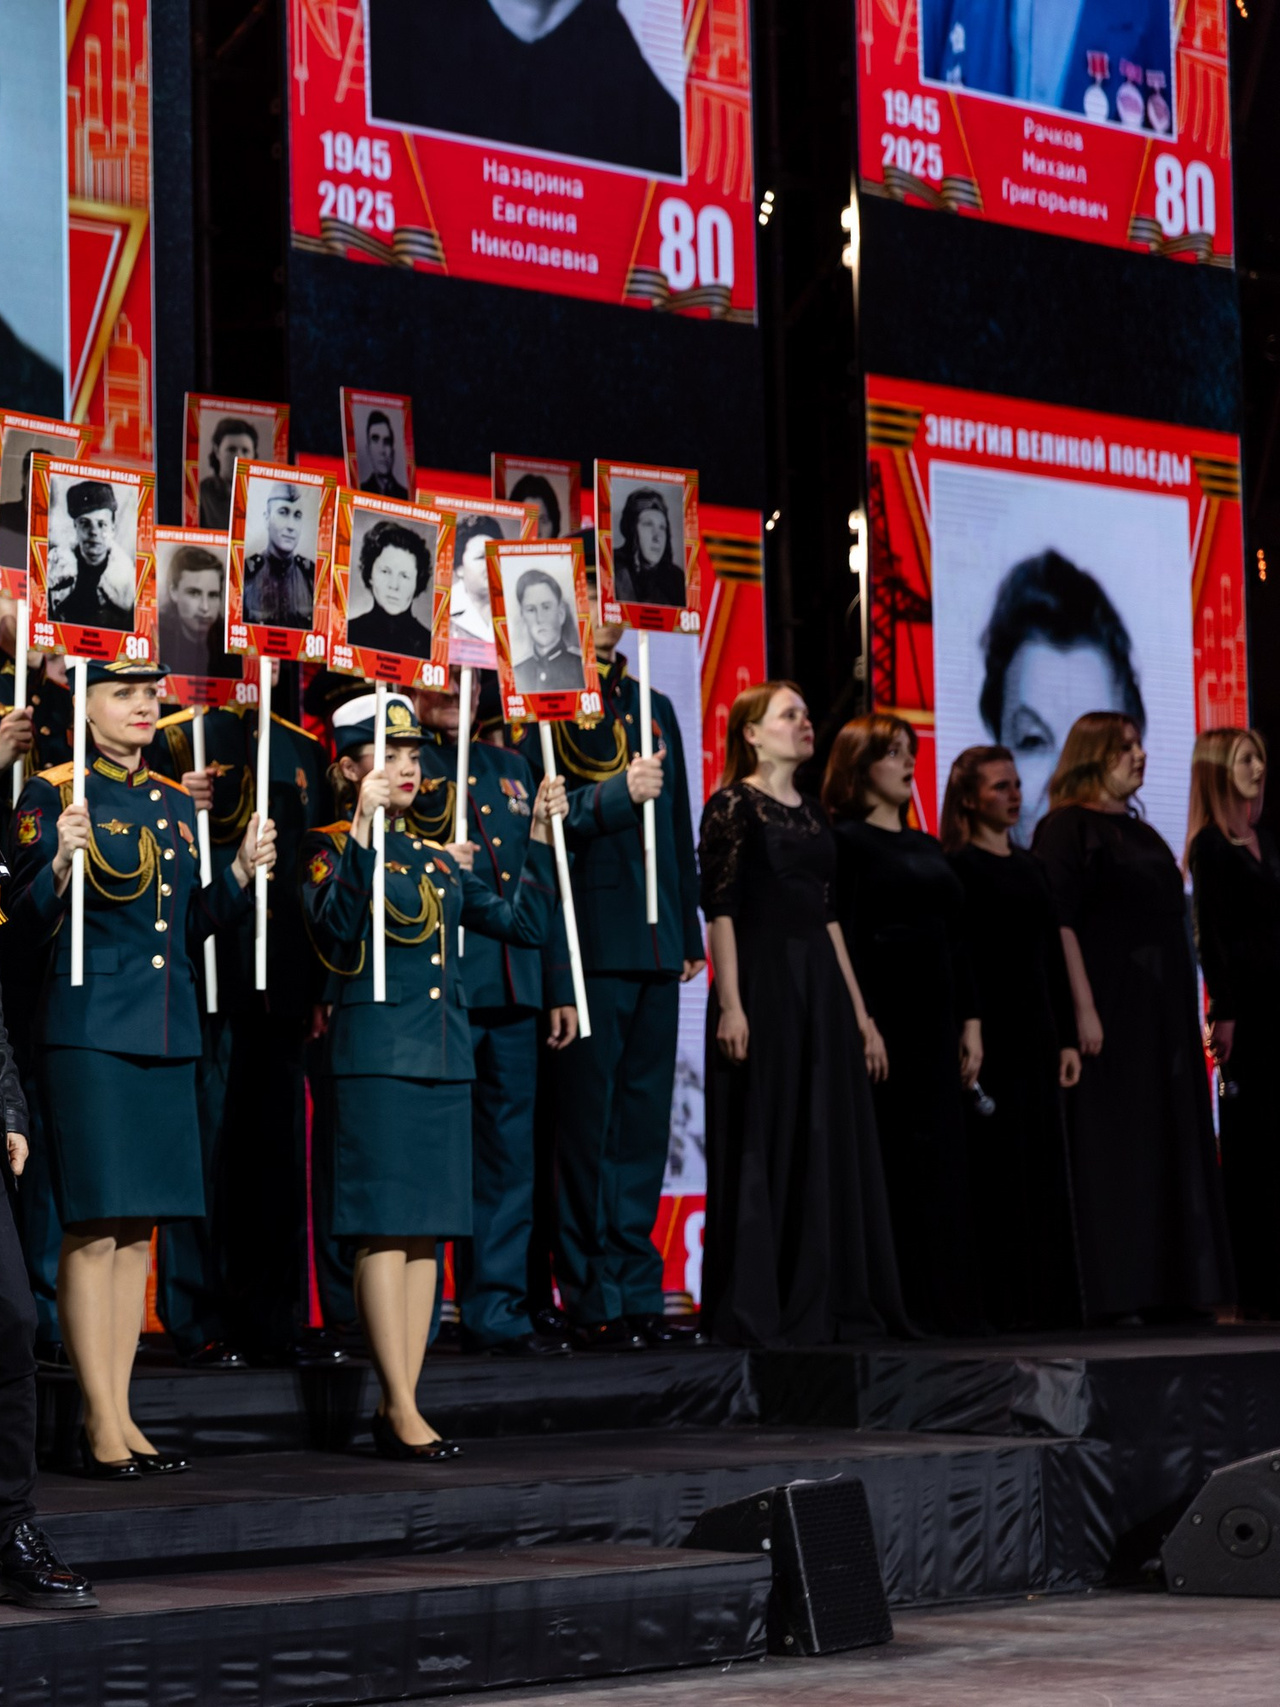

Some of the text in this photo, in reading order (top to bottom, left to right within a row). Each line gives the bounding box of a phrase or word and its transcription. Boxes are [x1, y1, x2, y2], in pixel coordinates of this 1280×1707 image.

[882, 88, 940, 135] 1945
[1024, 116, 1084, 152] Рачков
[320, 130, 392, 181] 1945
[881, 132, 943, 180] 2025
[1022, 148, 1087, 184] Михаил
[483, 157, 584, 199] Назарина
[318, 181, 395, 232] 2025
[1002, 177, 1108, 222] Григорьевич
[1154, 152, 1215, 238] 80
[492, 196, 577, 234] Евгения
[471, 229, 599, 274] Николаевна
[659, 197, 734, 290] 80
[925, 414, 1191, 487] ЭНЕРГИЯ ВЕЛИКОЙ ПОБЕДЫ
[49, 461, 140, 483] ЭНЕРГИЯ ВЕЛИКОЙ ПОБЕДЫ
[249, 465, 324, 484] ЭНЕРГИЯ ВЕЛИКОЙ ПОБЕДЫ
[353, 495, 441, 522] ЭНЕРГИЯ ВЕЛИКОЙ ПОБЕДЫ
[34, 622, 54, 635] 1945
[231, 625, 247, 636] 1945
[680, 611, 700, 631] 80
[33, 634, 55, 647] 2025
[126, 636, 149, 660] 80
[230, 637, 248, 648] 2025
[305, 634, 325, 658] 80
[334, 645, 353, 656] 1945
[332, 656, 353, 669] 2025
[422, 663, 445, 686] 80
[235, 682, 258, 704] 80
[580, 692, 601, 715] 80
